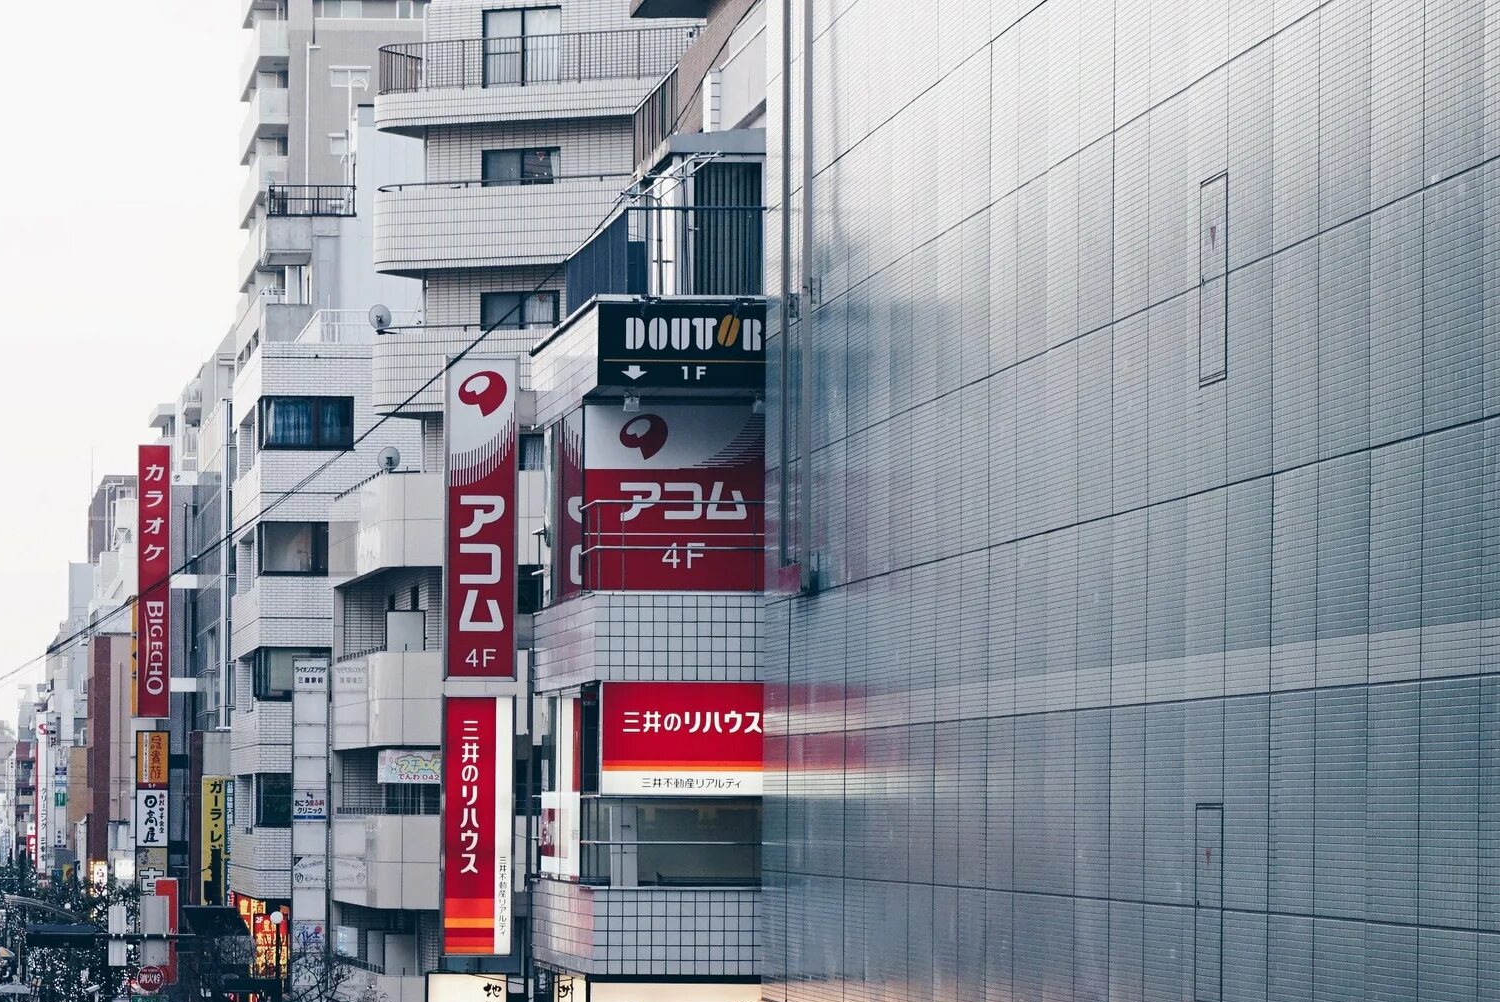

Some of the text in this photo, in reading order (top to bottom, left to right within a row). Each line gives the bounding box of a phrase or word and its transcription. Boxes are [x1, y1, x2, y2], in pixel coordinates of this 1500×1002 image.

[625, 314, 762, 352] DOUTOR
[681, 365, 707, 381] 1F
[142, 464, 165, 563] カラオケ
[619, 481, 748, 521] アコム
[459, 495, 505, 633] アコム
[661, 542, 706, 570] 4F
[464, 648, 497, 668] 4F
[622, 711, 763, 735] 三井のリハウス
[460, 720, 480, 873] 三井のリハウス
[640, 776, 742, 790] 三井不動産リアルティ
